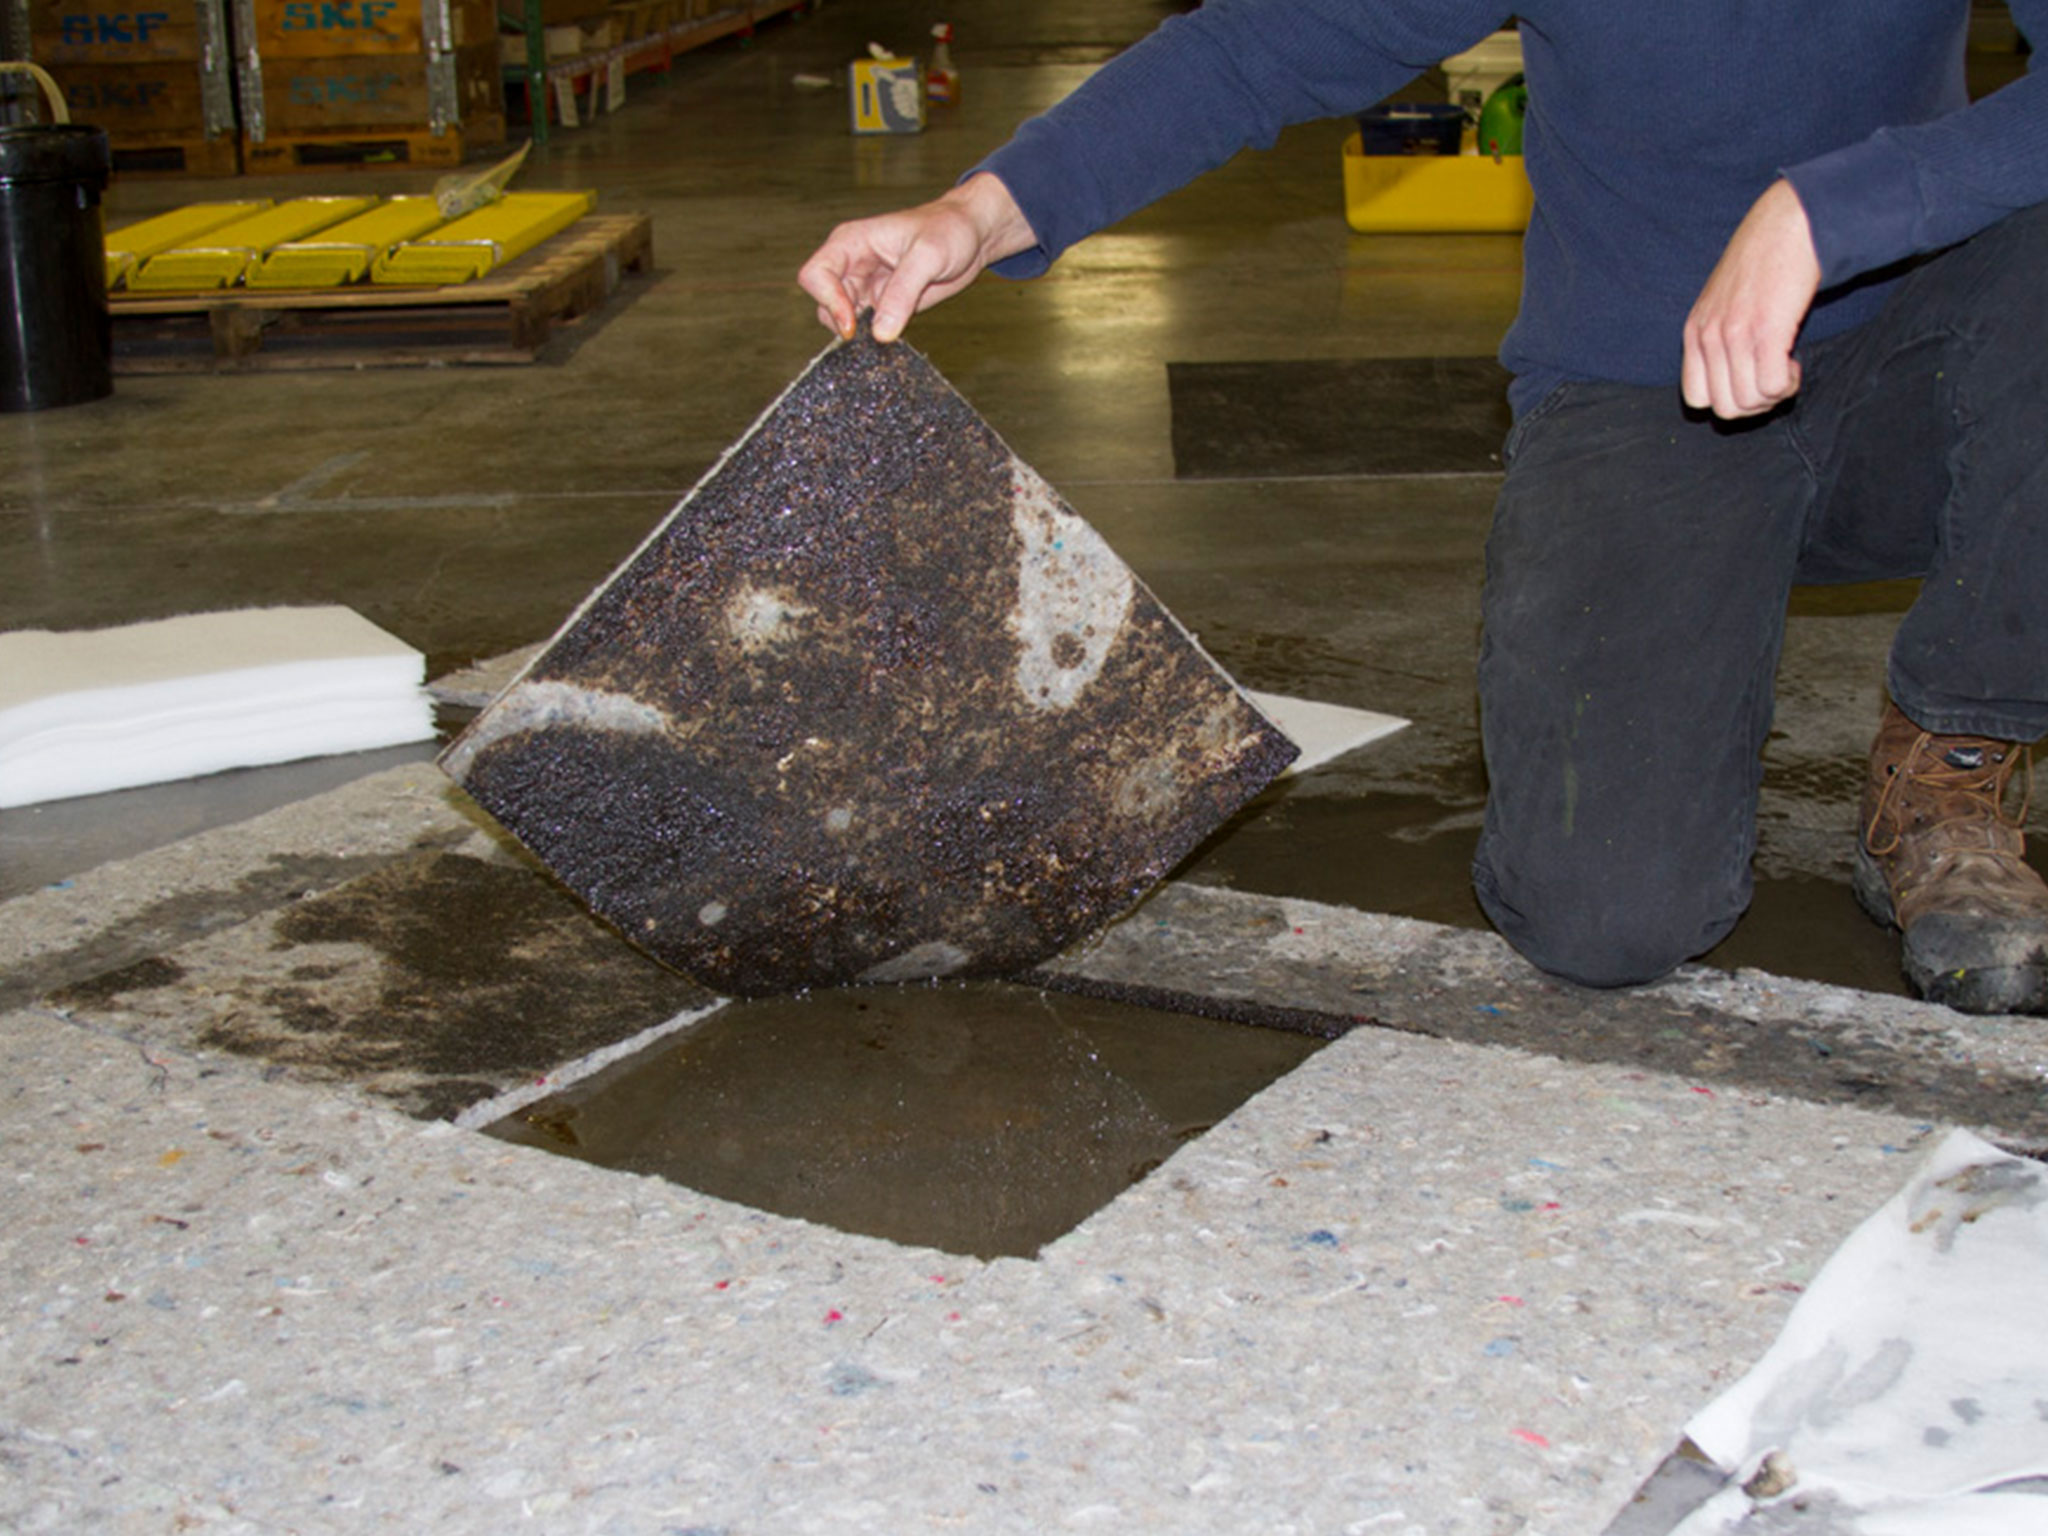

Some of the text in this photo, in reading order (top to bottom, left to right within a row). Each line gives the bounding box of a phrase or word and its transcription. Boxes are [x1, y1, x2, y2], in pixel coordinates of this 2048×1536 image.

[62, 12, 168, 44] SKF
[282, 1, 396, 31] SKF
[68, 81, 168, 109] SKF
[290, 73, 399, 104] SKF
